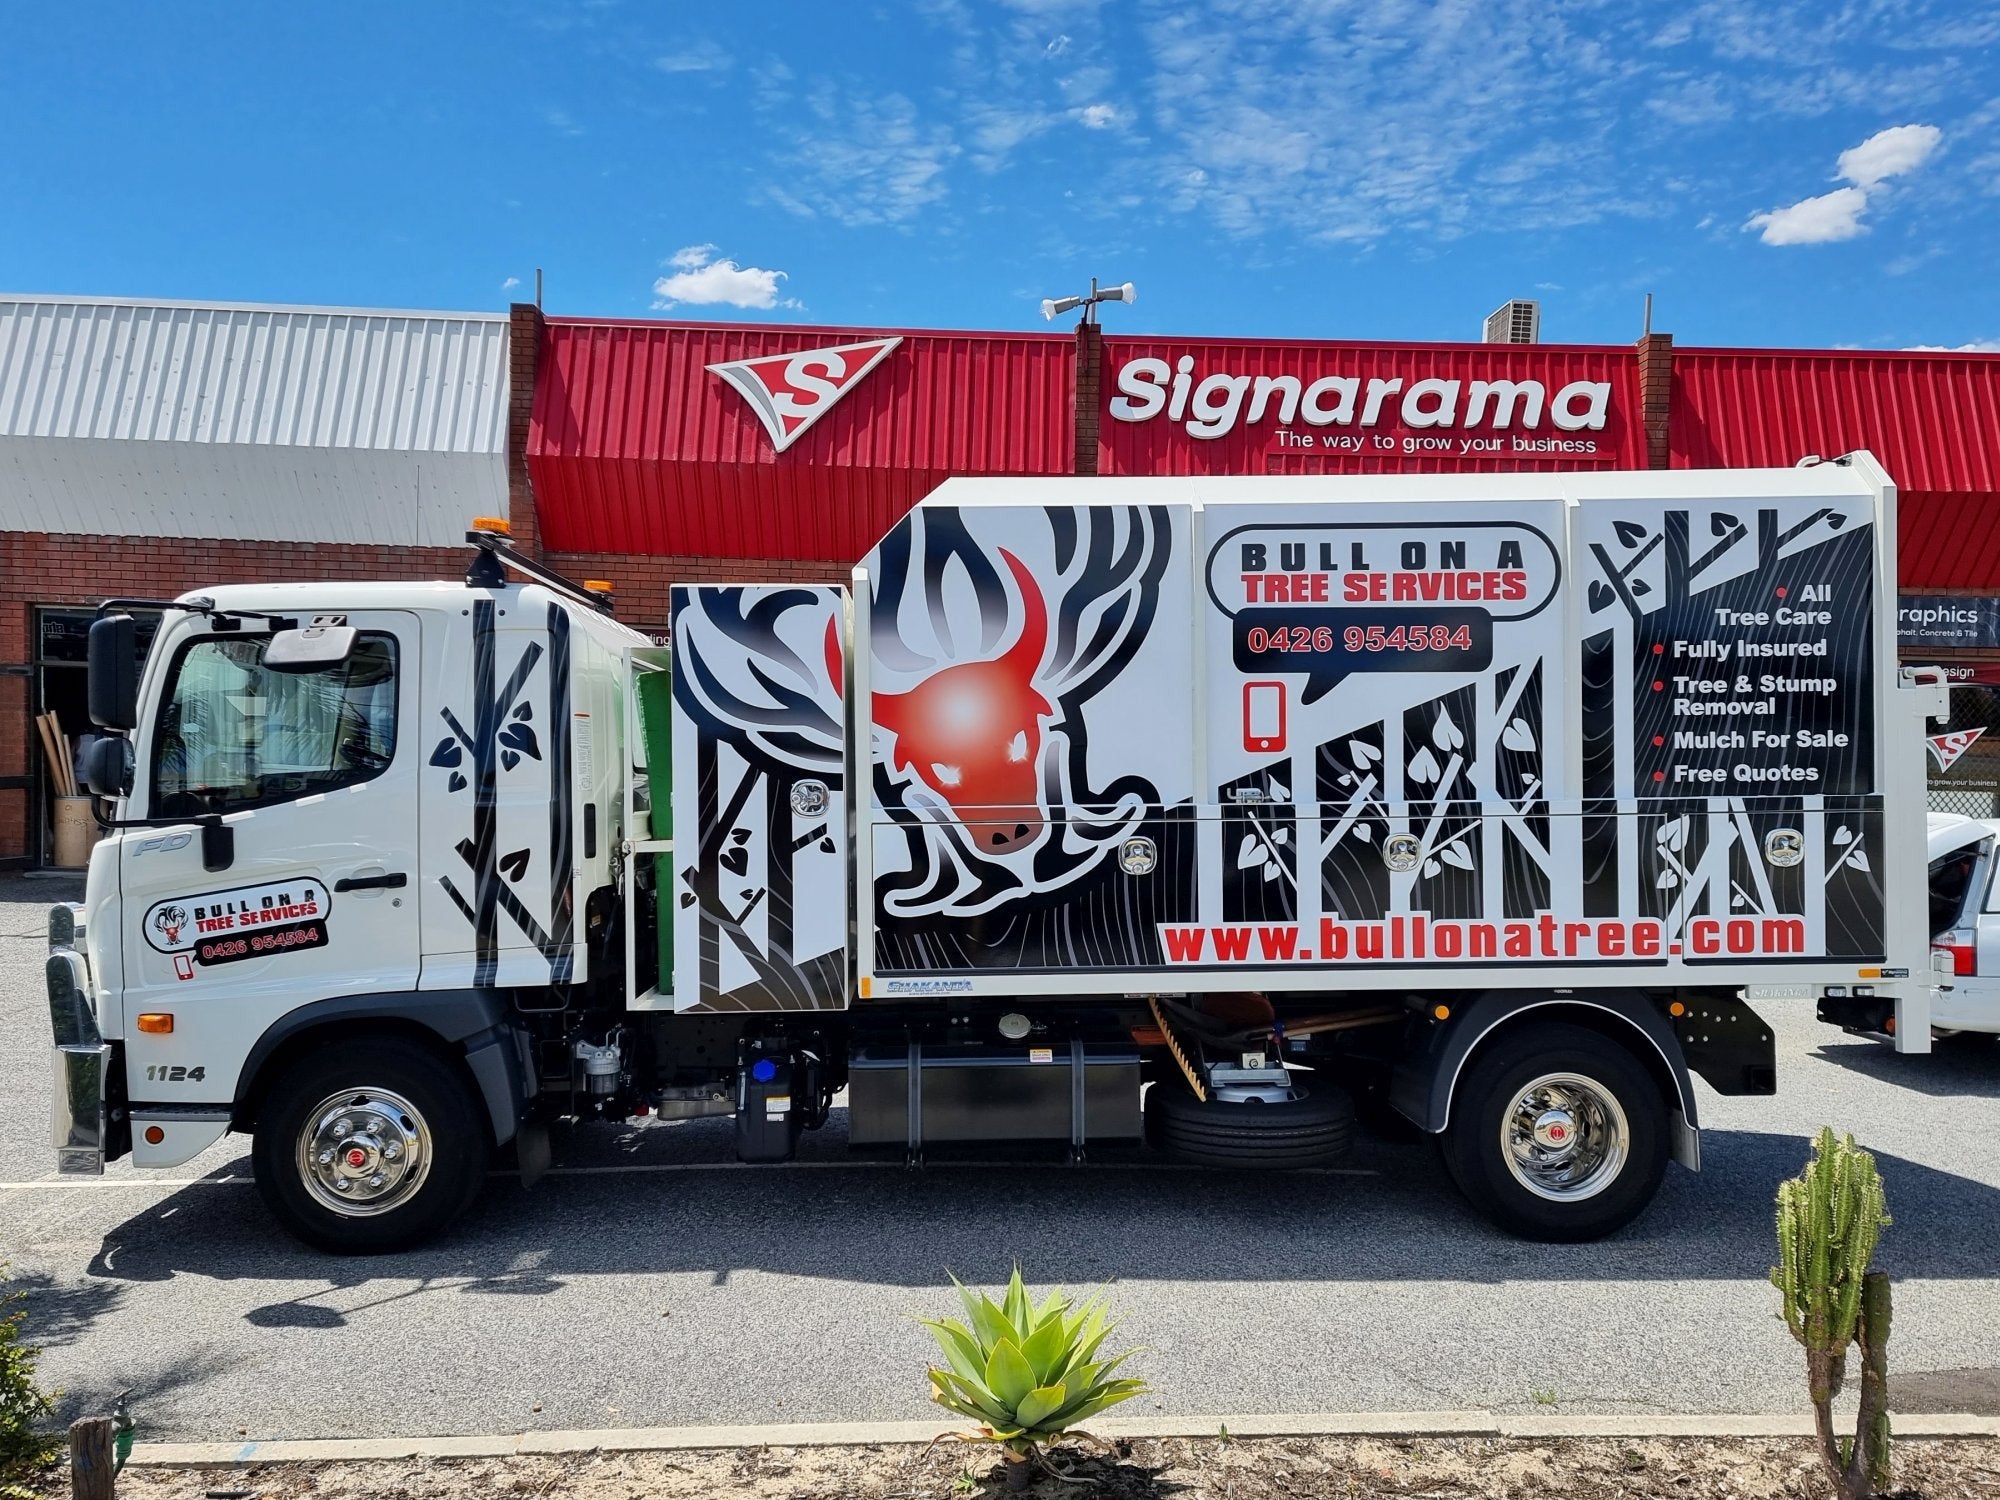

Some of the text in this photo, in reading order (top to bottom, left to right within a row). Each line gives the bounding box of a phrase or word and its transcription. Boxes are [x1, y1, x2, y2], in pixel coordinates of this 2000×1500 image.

[1109, 355, 1611, 439] Signarama
[1275, 430, 1597, 455] The way to grow your business
[1241, 540, 1524, 572] BULL ON A
[1240, 571, 1528, 603] TREE SERVICES
[1800, 584, 1831, 602] All
[1715, 607, 1832, 626] Tree Care
[1897, 605, 1978, 626] raphics
[1248, 625, 1472, 653] 0426 954584
[1920, 629, 1955, 637] Concrete
[1674, 638, 1827, 662] Fully Insured
[1942, 666, 1975, 680] esign
[1673, 674, 1837, 696] Tree & Stump
[1674, 697, 1775, 716] Removal
[1674, 729, 1849, 749] Mulch For Sale
[1674, 763, 1819, 783] Free Quotes
[1968, 778, 1998, 787] business
[132, 832, 192, 857] FD
[194, 900, 249, 921] BULL
[260, 893, 291, 909] ON
[195, 902, 318, 933] TREE SERVICES
[202, 928, 319, 959] 0426 954584
[1164, 915, 1805, 961] www.bullonatree.com
[887, 980, 973, 993] SHAKANDA
[146, 1065, 206, 1082] 1124
